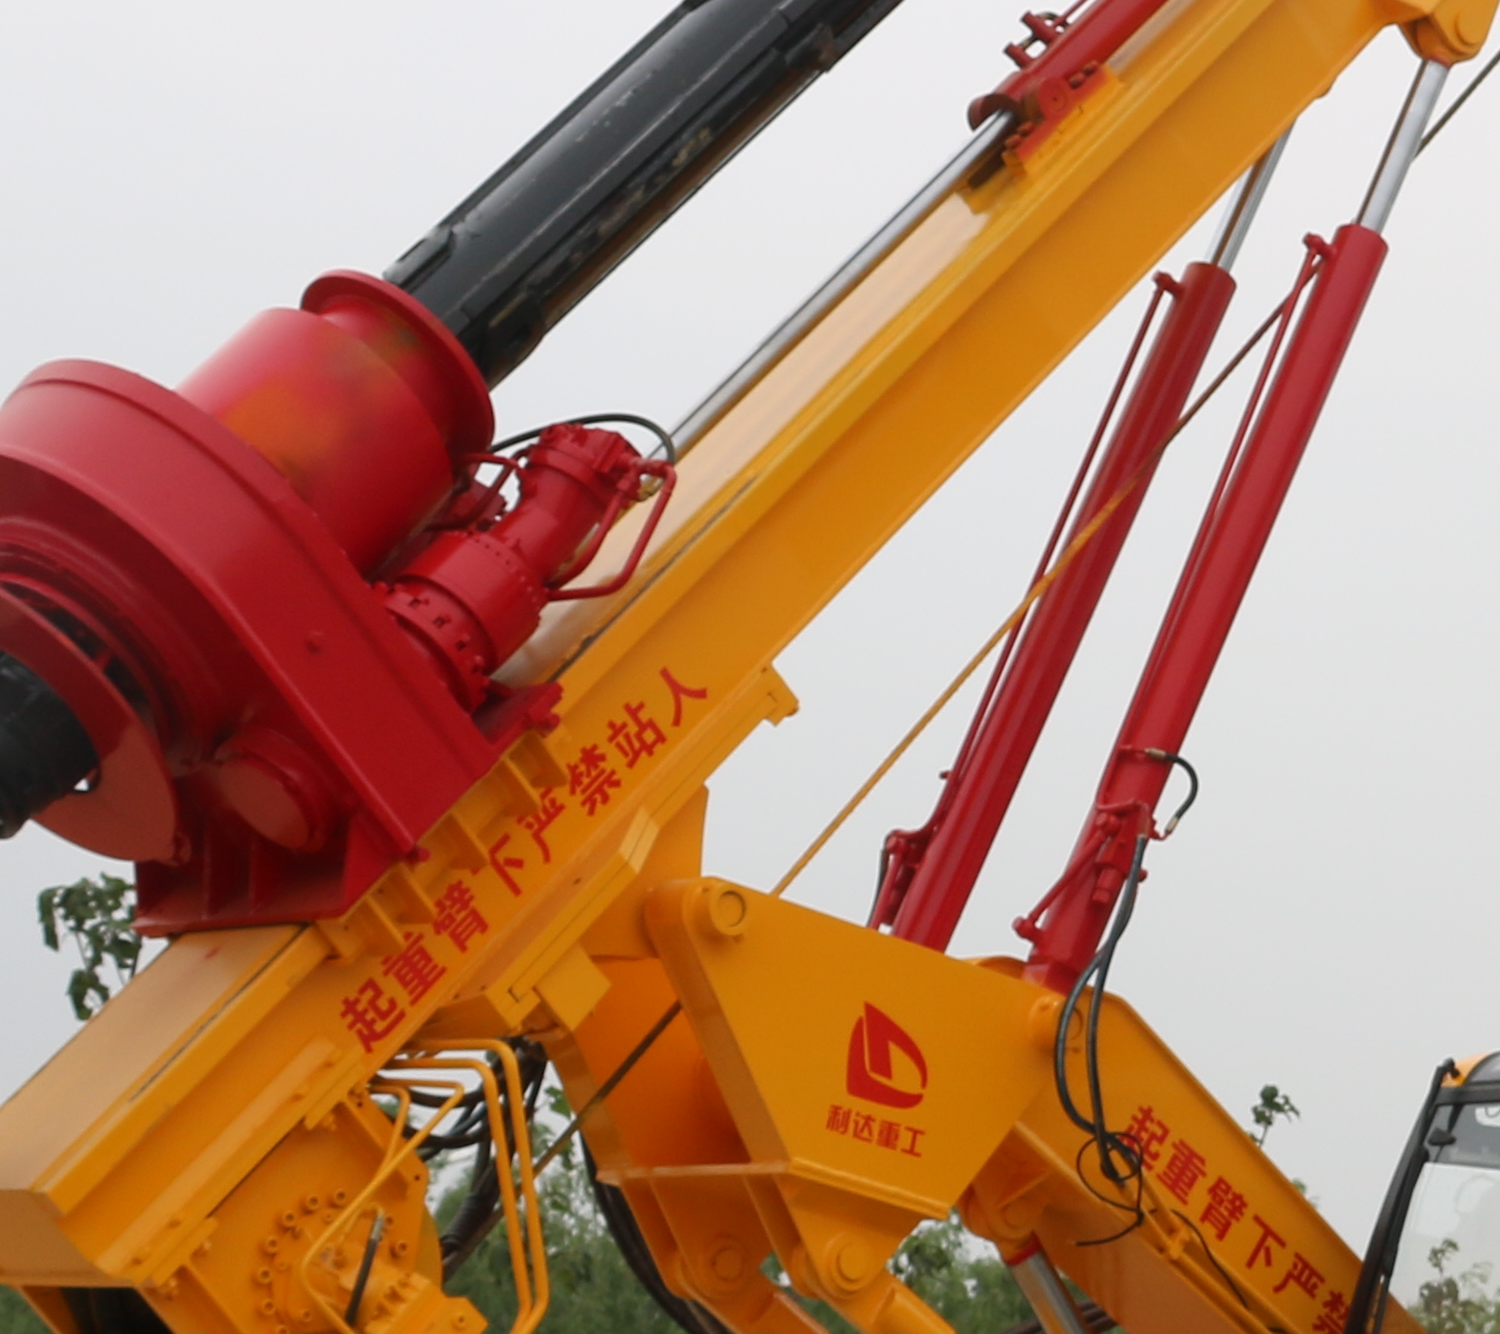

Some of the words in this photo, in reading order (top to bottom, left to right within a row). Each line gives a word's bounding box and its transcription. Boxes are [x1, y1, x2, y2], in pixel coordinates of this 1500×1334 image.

[339, 667, 708, 1053] 起重臂下严禁站人
[826, 1104, 926, 1158] 利达重工
